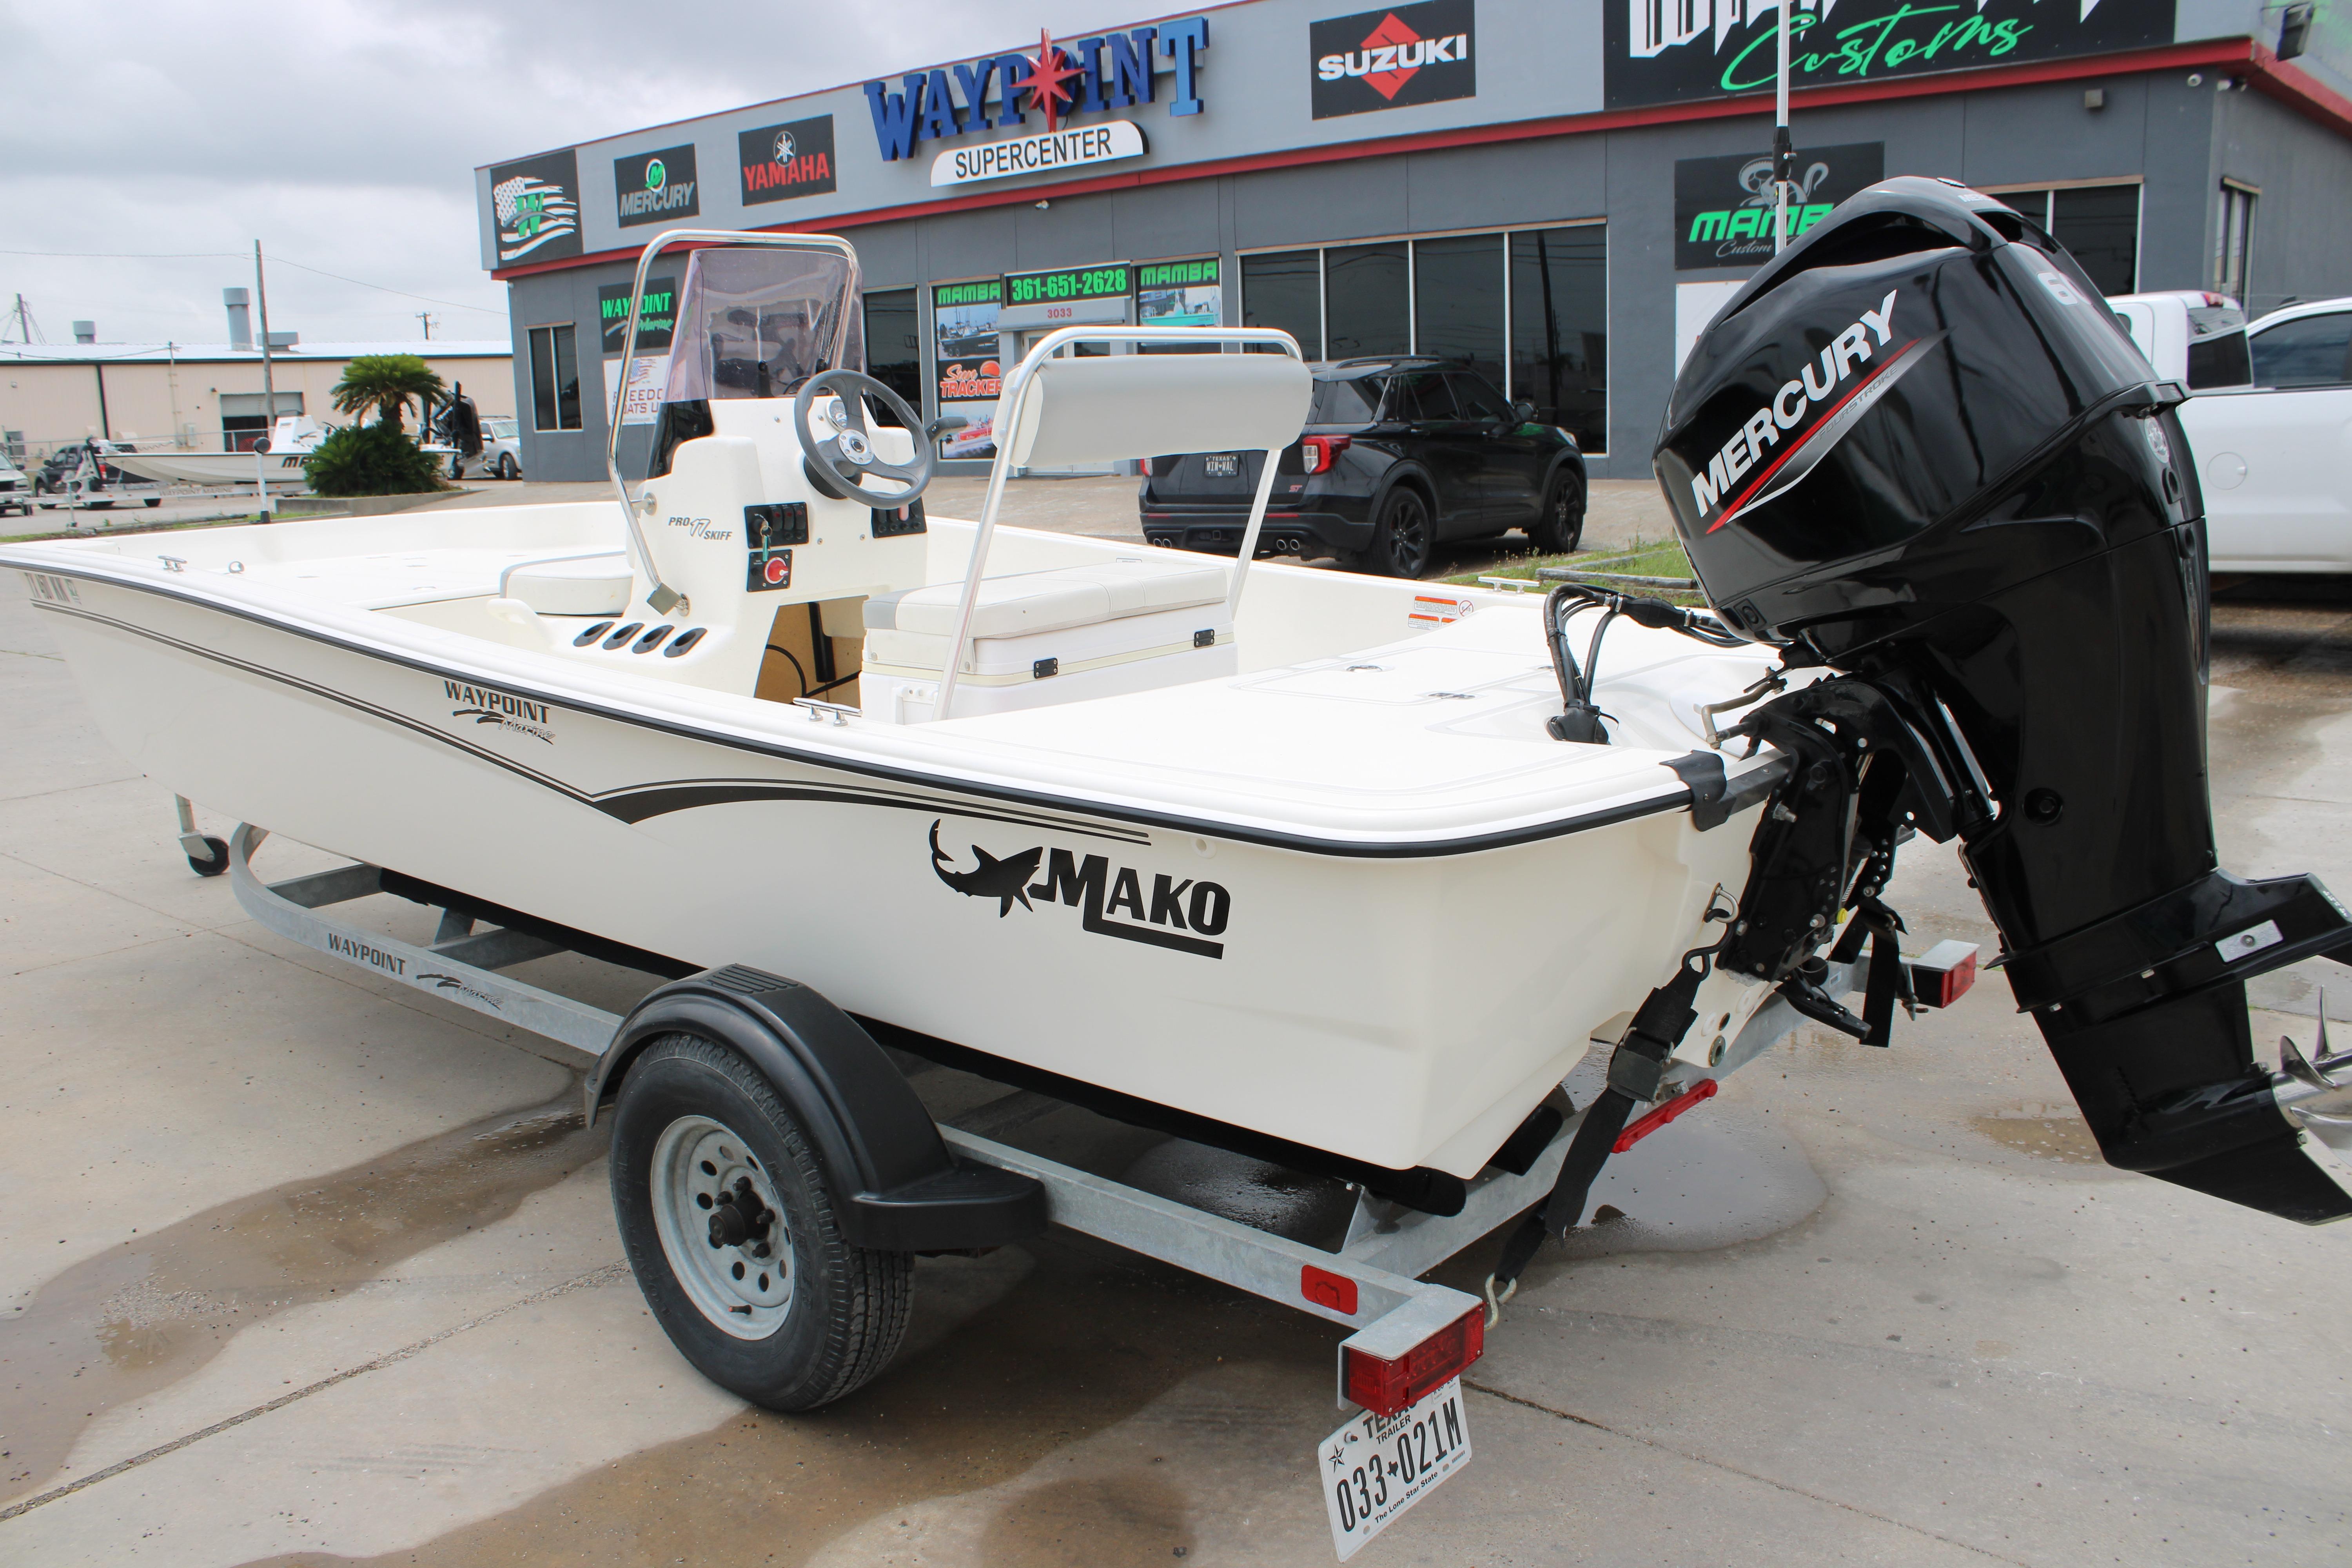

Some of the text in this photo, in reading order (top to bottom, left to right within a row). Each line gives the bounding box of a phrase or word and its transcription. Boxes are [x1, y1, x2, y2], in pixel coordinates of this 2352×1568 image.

[1319, 34, 1467, 81] SUZUKI
[1721, 4, 2034, 90] Customs
[864, 16, 1209, 162] WAYPOINT
[743, 153, 830, 192] YAMAHA
[955, 128, 1112, 179] SUPERCENTER
[620, 181, 695, 217] MERCURY
[1689, 203, 1835, 242] MAMB
[1716, 240, 1771, 258] Custom
[1012, 269, 1127, 301] 361-651-2628
[1141, 261, 1217, 286] MAMBA
[602, 292, 671, 318] WAYOINT
[938, 282, 1001, 305] MAMBA
[1047, 308, 1072, 318] 3033
[943, 364, 978, 382] Sun
[1691, 289, 1897, 518] MERCURY
[1817, 364, 1897, 441] FOURSTROKE
[668, 517, 733, 541] PRO 17 SKIFF
[445, 680, 550, 724] WAYPOINT
[498, 718, 556, 740] Marine
[1027, 847, 1231, 960] MAKO
[328, 933, 505, 1007] WAYPOINT Marine
[1376, 1414, 1411, 1445] TRAILER
[1375, 1472, 1438, 1524] The Lone Star State
